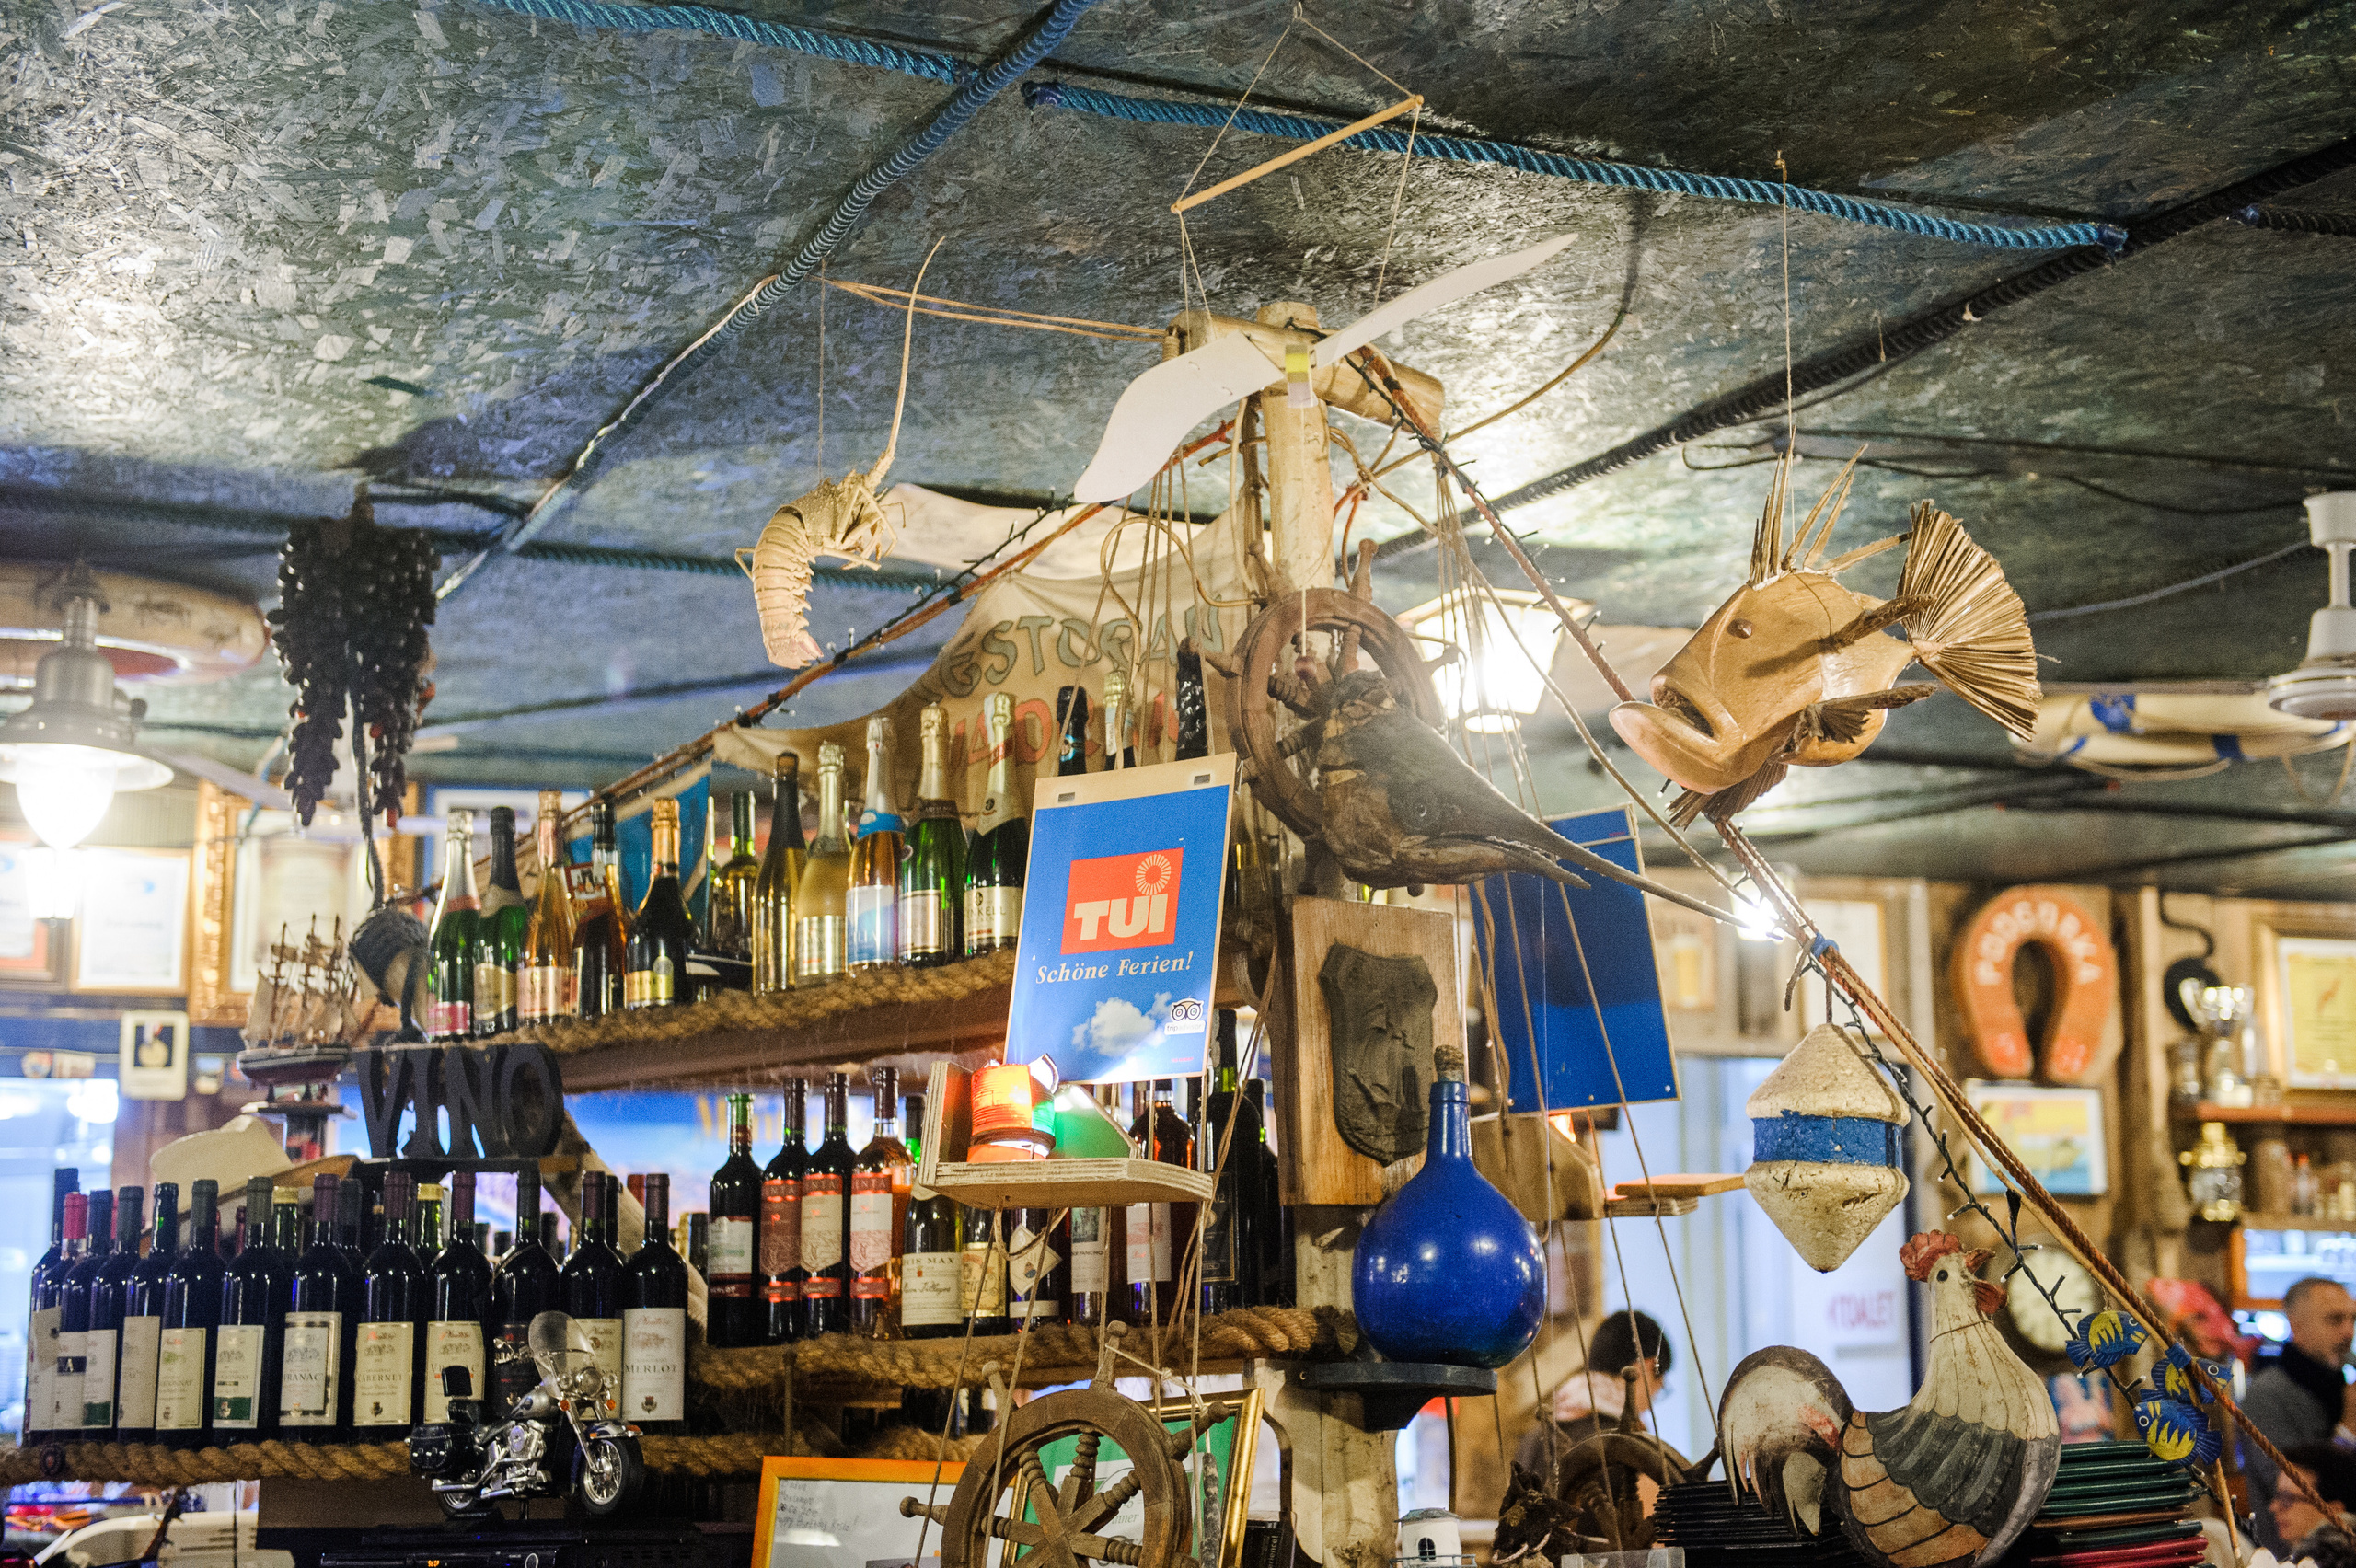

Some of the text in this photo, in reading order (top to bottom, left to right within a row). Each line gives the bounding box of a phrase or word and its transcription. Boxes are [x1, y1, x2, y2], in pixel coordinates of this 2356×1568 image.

[1074, 876, 1170, 940] TUI
[1035, 951, 1194, 985] Schöne Ferien!
[357, 1043, 564, 1158] VINO
[625, 1363, 679, 1375] MERLOT
